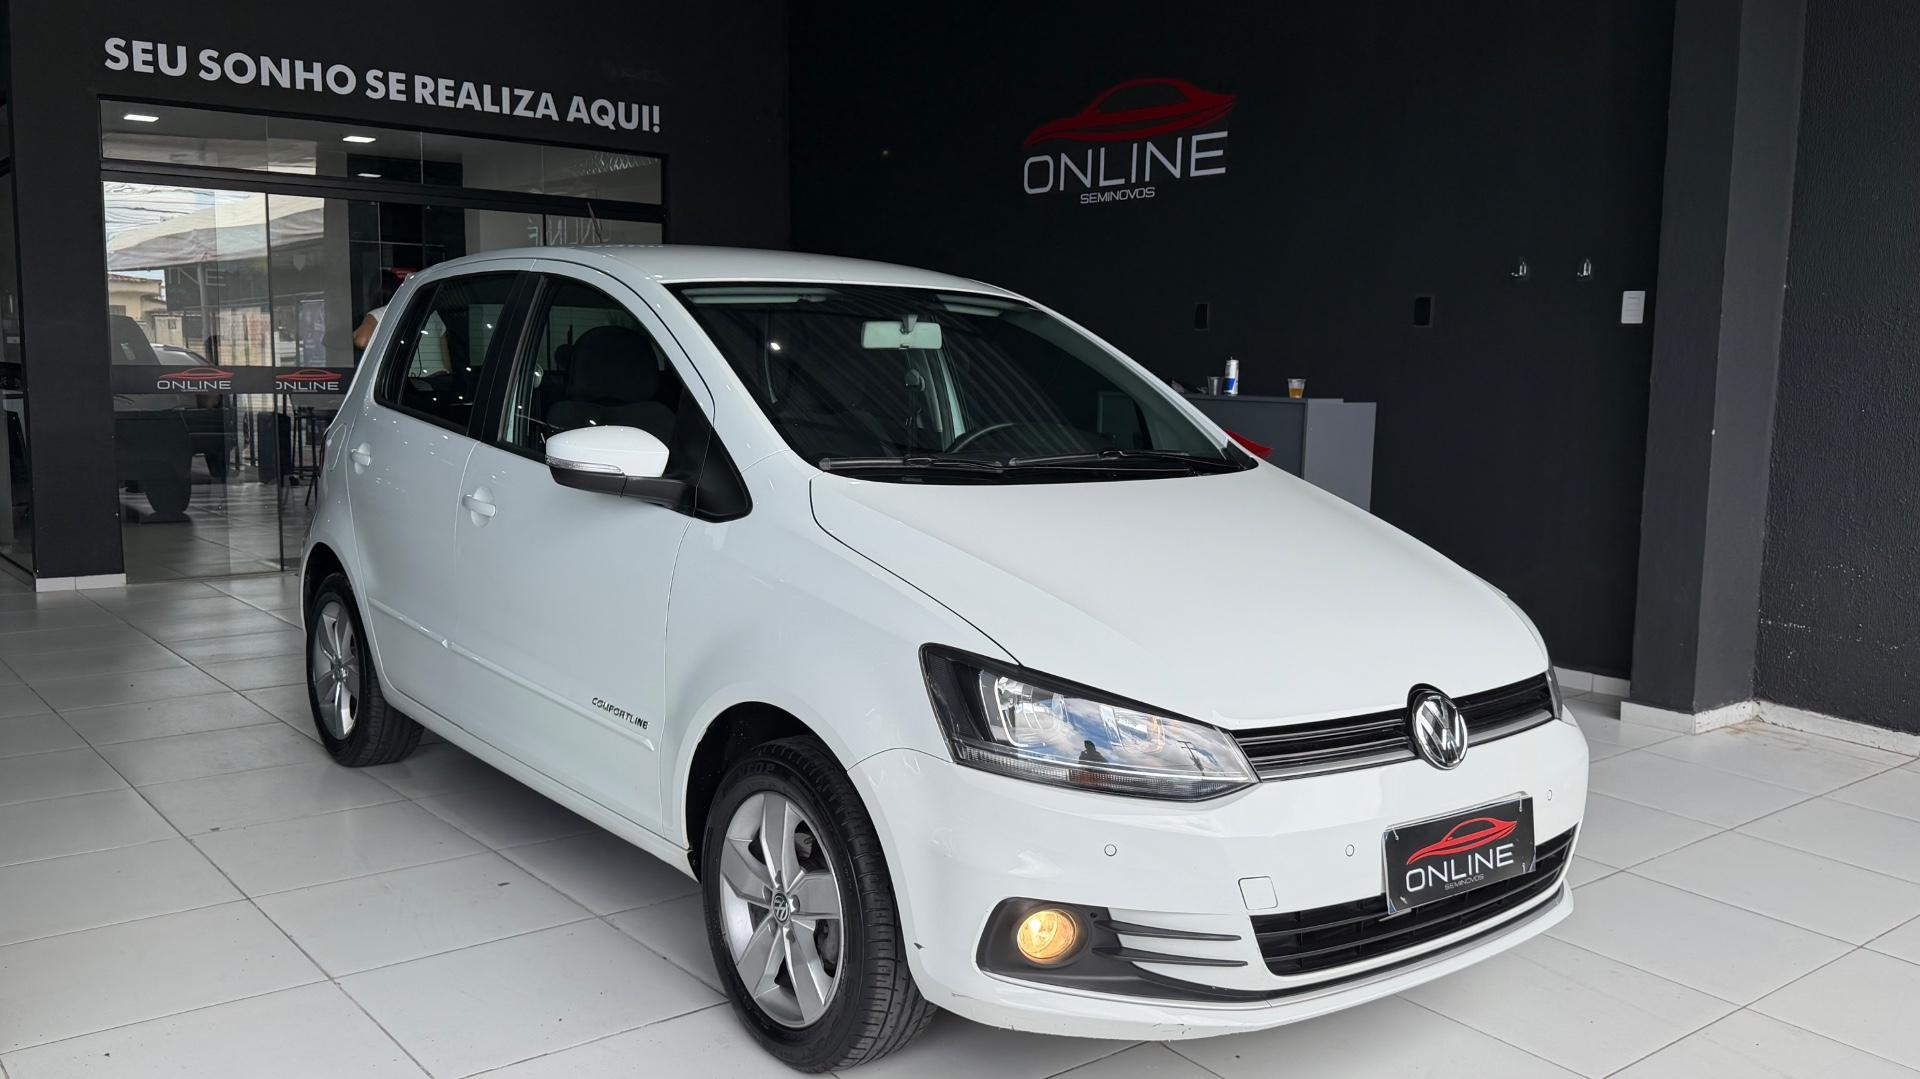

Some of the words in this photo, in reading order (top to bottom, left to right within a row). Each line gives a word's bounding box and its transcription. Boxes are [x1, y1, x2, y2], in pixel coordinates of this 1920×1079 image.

[104, 37, 188, 77] SEU
[198, 48, 357, 95] SONHO
[365, 69, 408, 102] SE
[414, 75, 560, 122] REALIZA
[566, 95, 662, 134] AQUI!
[1023, 130, 1229, 195] ONLINE
[1079, 186, 1156, 205] SEMINOVOS
[156, 379, 232, 391] ONLINE
[1405, 842, 1515, 893] ONLINE
[1444, 873, 1485, 891] SEMINOVOS
